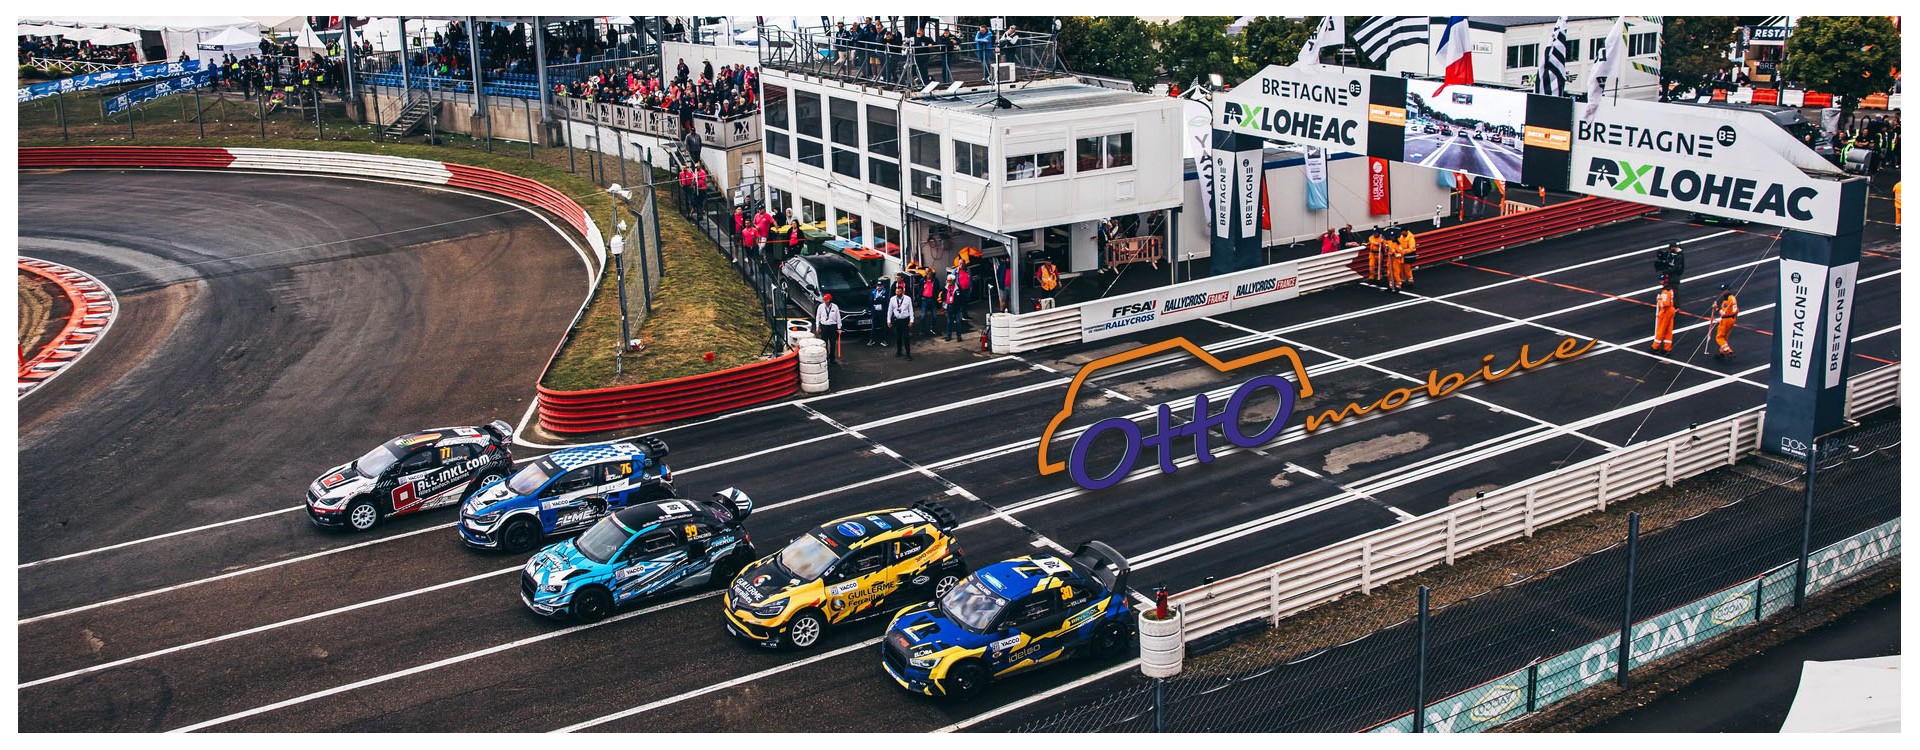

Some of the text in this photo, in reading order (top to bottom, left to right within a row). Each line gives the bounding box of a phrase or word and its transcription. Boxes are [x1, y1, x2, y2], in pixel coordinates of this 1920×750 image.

[1262, 77, 1348, 107] BRETAGNE
[1578, 119, 1714, 158] BRETAGNE
[1219, 166, 1227, 226] BRETAGNE
[1245, 166, 1254, 226] BRETAGNE
[1235, 276, 1297, 297] RALLYCROSS FRANCE
[1112, 300, 1154, 318] FFSA
[1163, 291, 1229, 312] RALLYCROSS FRANCE
[1105, 313, 1155, 330] RALLYCROSS
[1789, 285, 1808, 369] BRETAGNE
[1829, 287, 1846, 371] BRETAGNE
[440, 447, 451, 459] 77
[621, 462, 632, 475] 76
[685, 524, 698, 539] 99
[626, 565, 645, 576] YACCO
[736, 577, 764, 601] GUILLERME
[840, 582, 857, 591] YACCO
[847, 581, 896, 601] GUILLERME
[1061, 585, 1073, 600] 30
[1000, 637, 1020, 647] YACCO
